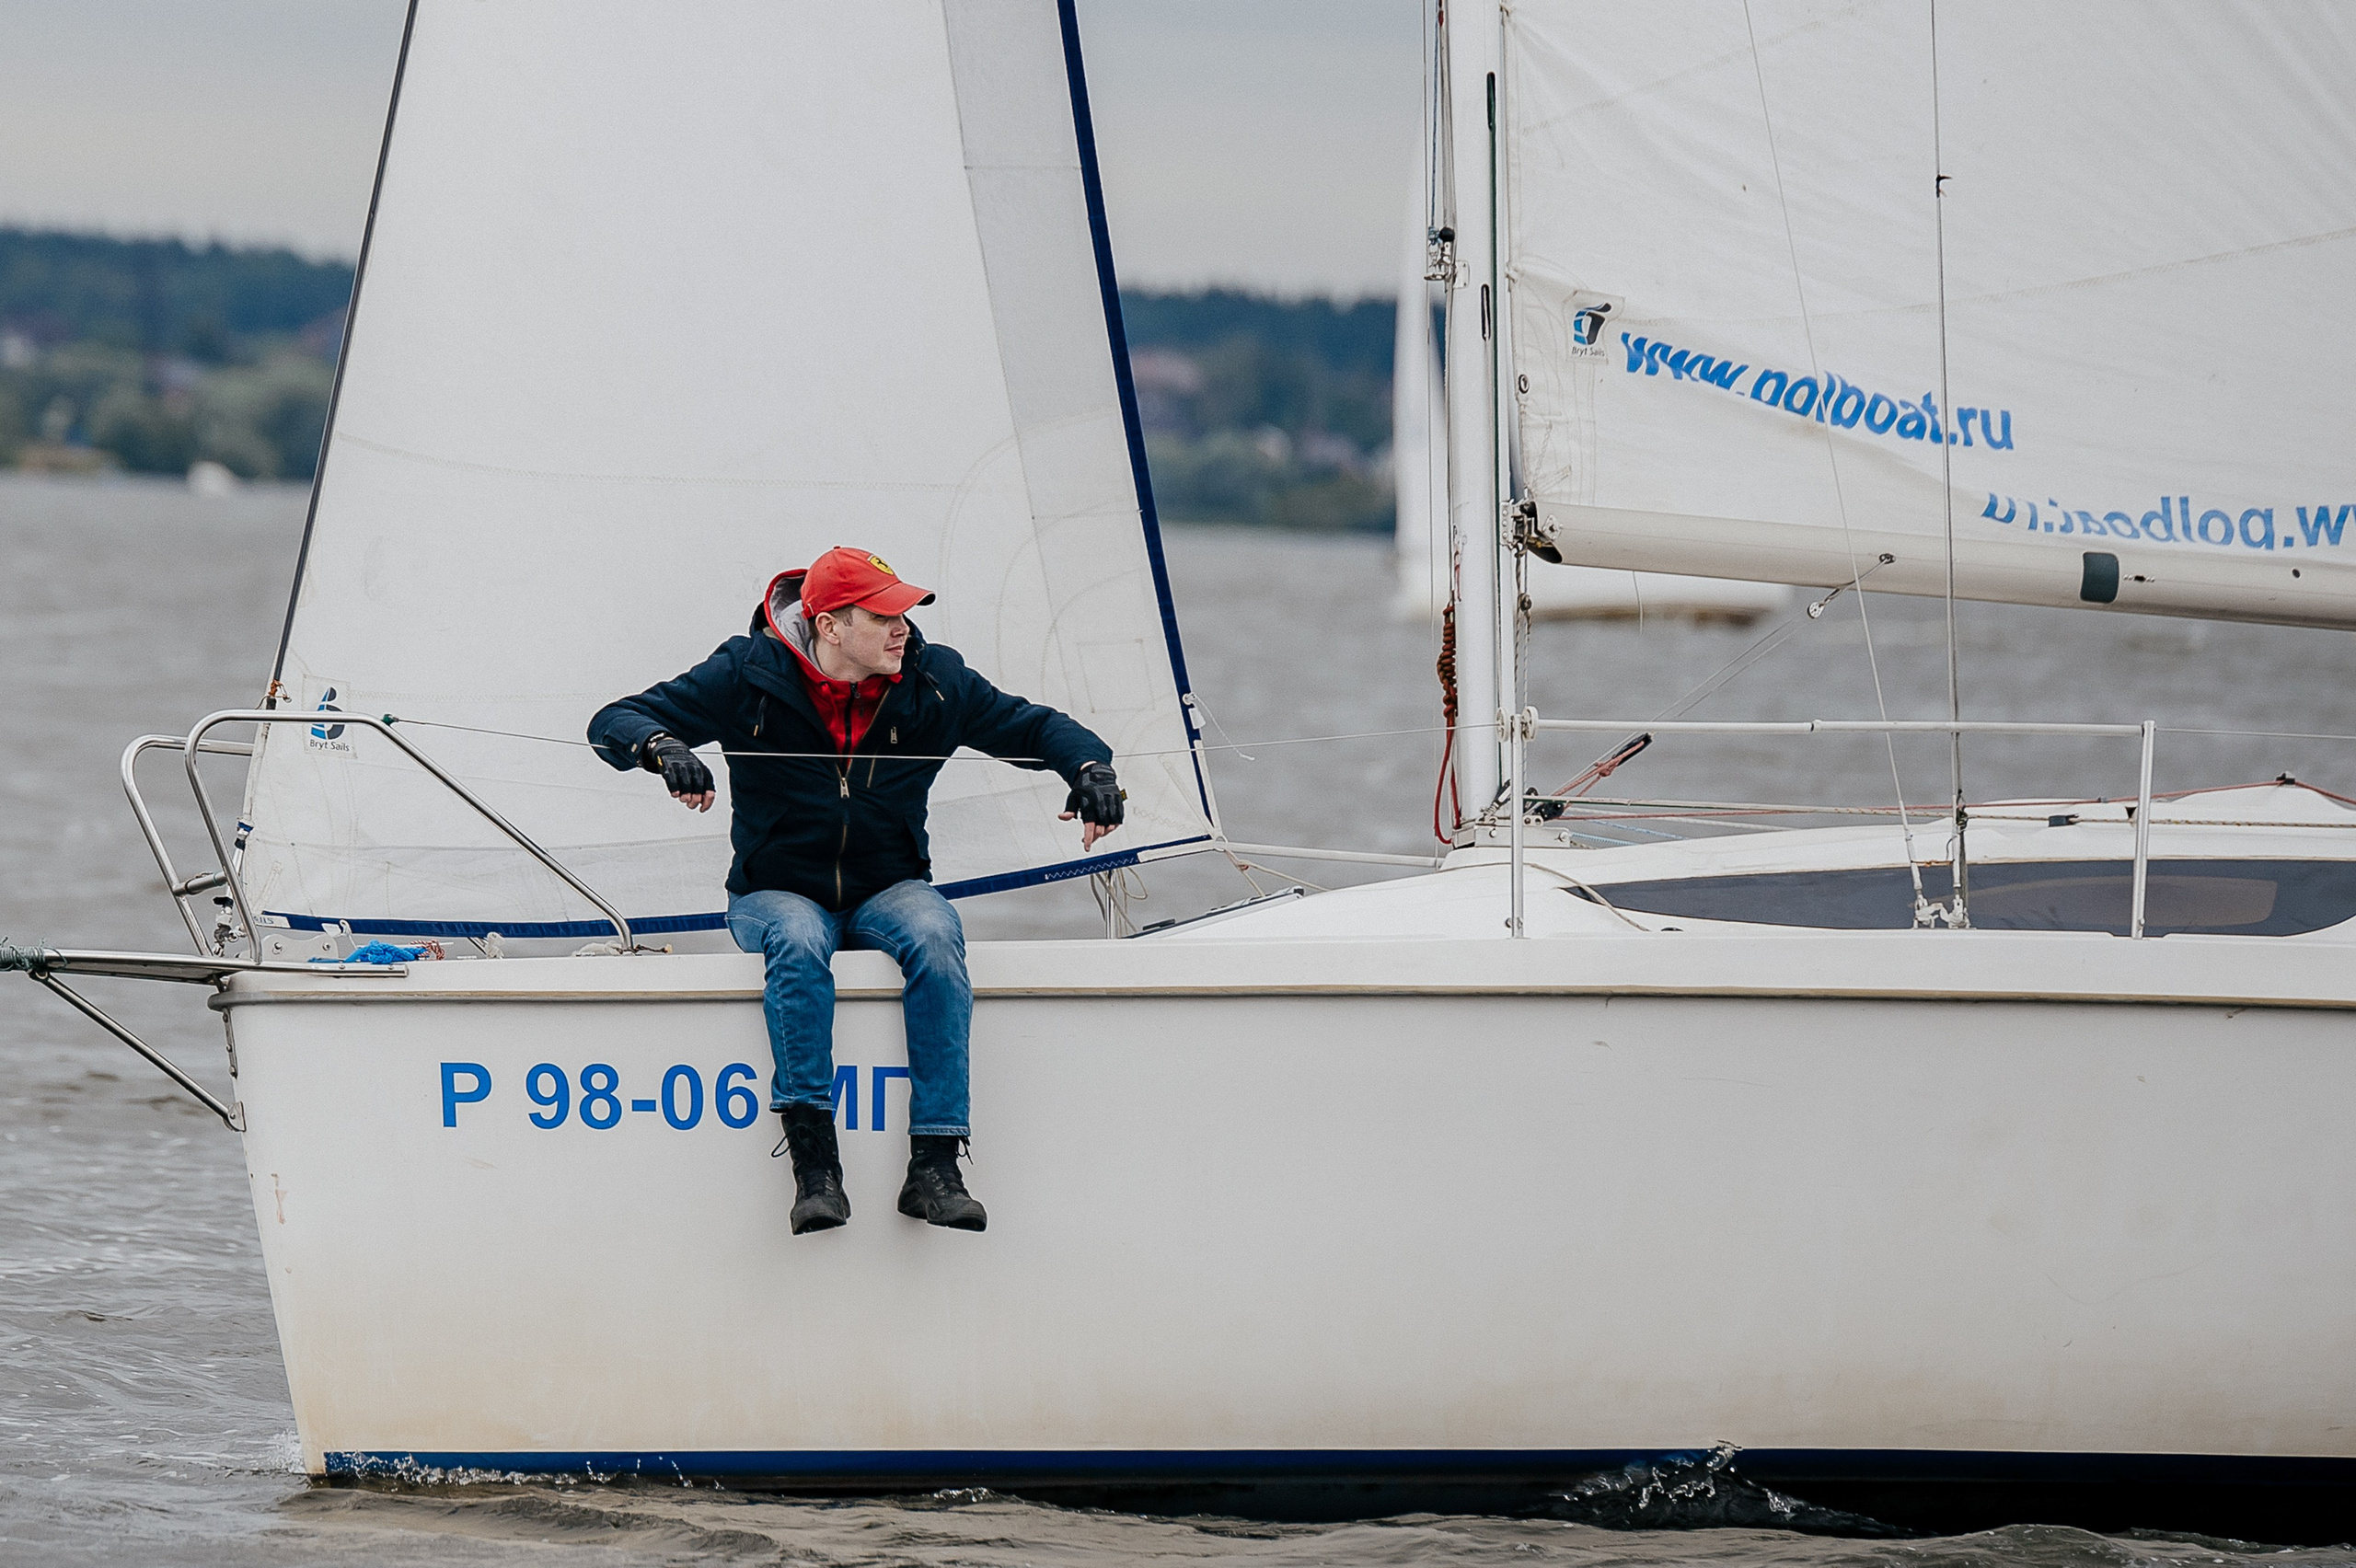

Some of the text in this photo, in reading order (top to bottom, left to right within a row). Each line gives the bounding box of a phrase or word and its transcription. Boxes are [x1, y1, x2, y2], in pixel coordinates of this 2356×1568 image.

[309, 739, 350, 752] Bryt Sails
[525, 1062, 759, 1131] 98-06
